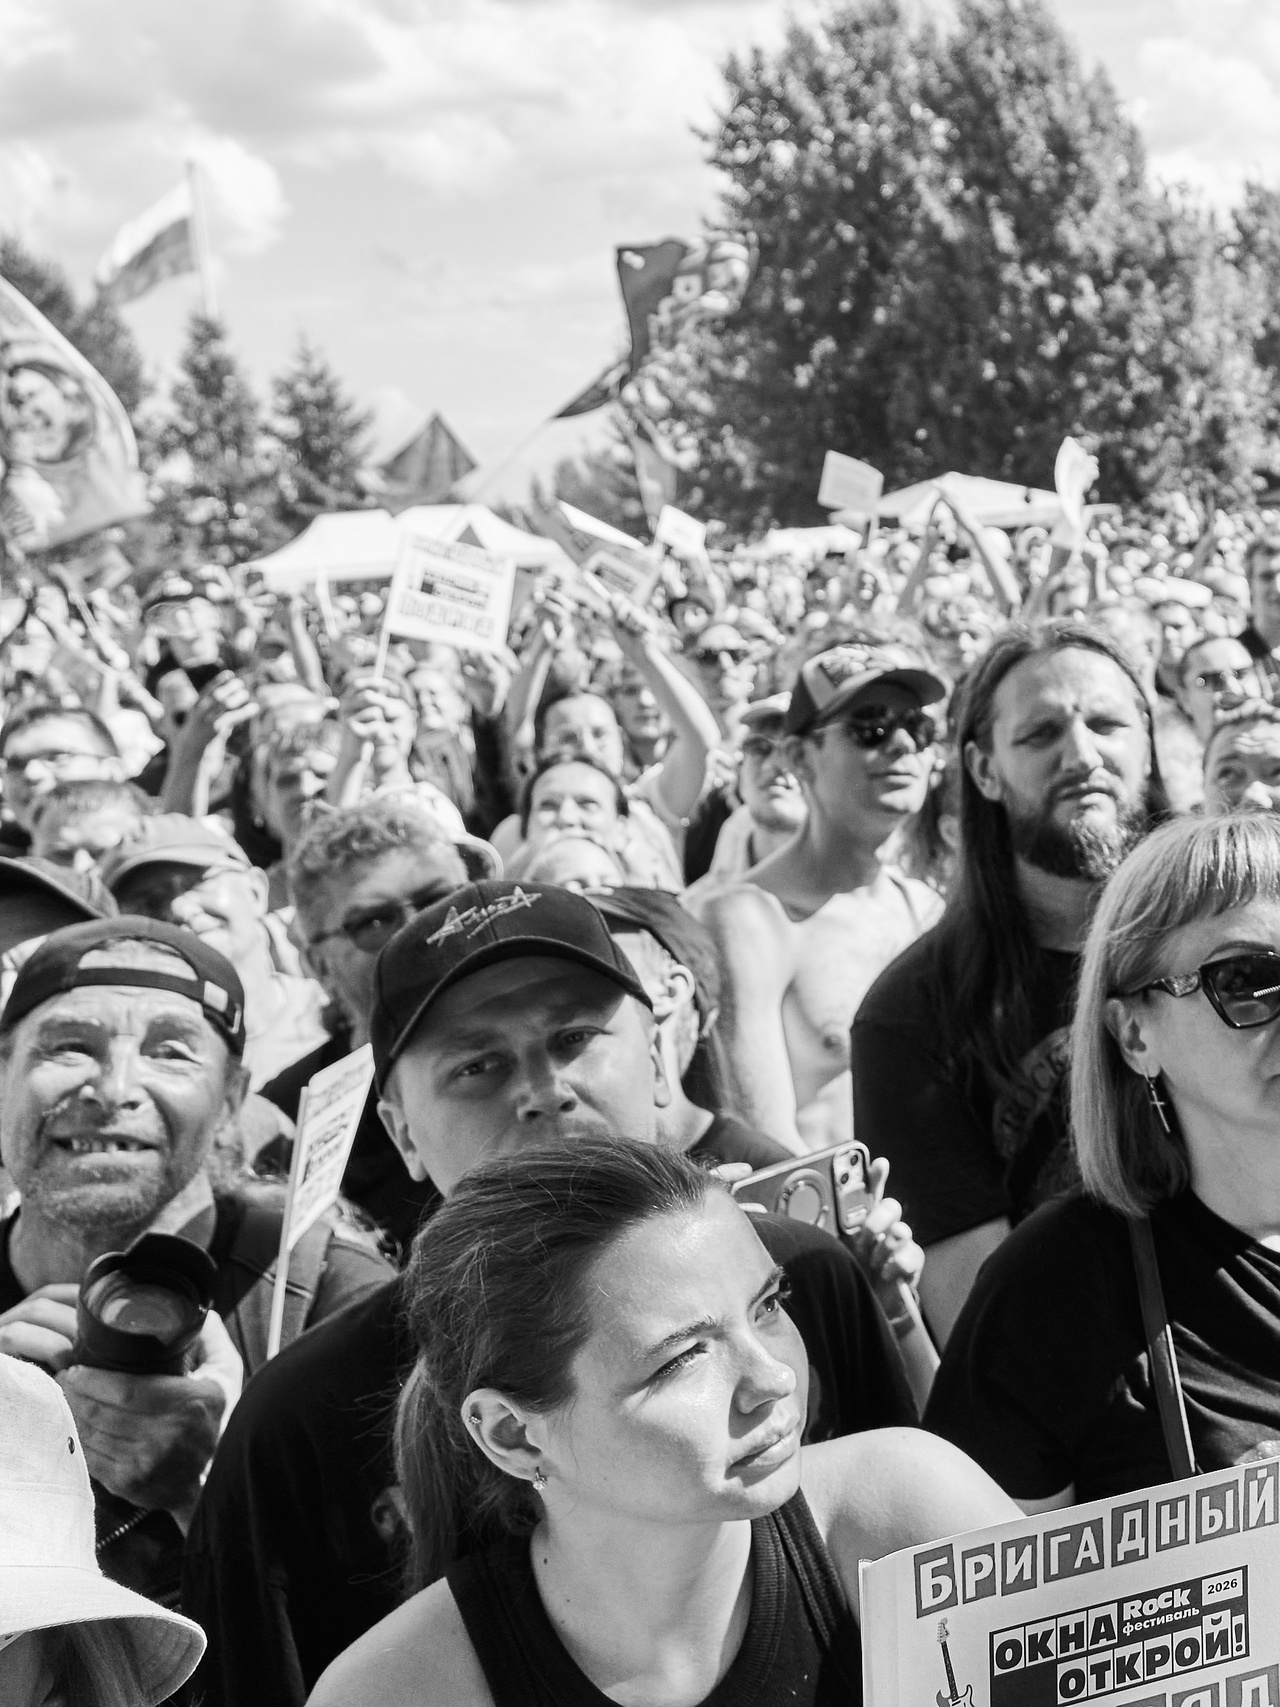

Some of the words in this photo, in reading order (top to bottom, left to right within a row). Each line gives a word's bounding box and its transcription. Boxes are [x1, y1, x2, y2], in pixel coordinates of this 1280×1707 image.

[917, 1467, 1277, 1612] БРИГАДНЫЙ
[1207, 1578, 1238, 1595] 2026
[995, 1614, 1117, 1670] ОКНА
[1122, 1607, 1200, 1637] фестиваль
[1058, 1614, 1246, 1700] ОТКРОЙ!
